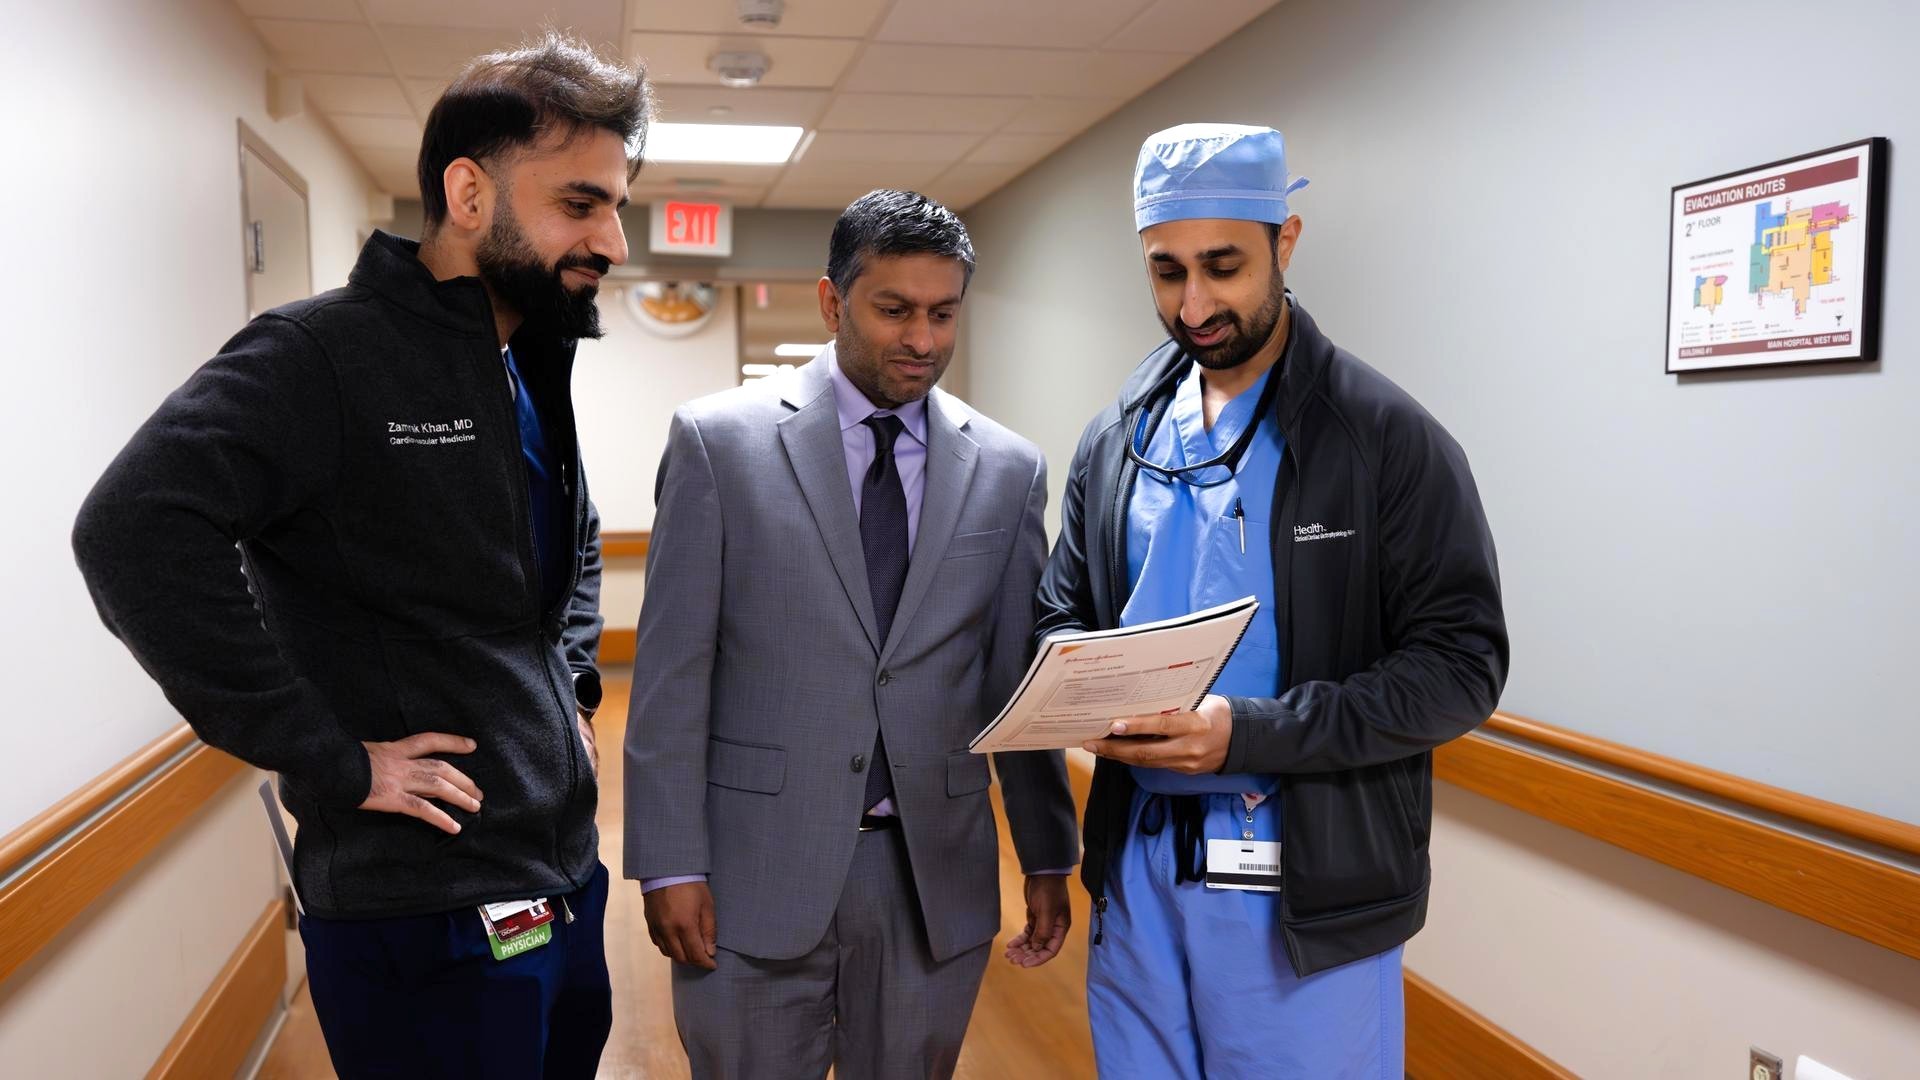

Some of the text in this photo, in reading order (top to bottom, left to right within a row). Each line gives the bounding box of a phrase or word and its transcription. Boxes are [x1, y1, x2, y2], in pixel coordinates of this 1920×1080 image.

[1685, 178, 1786, 212] EVACUATION ROUTES
[667, 203, 720, 244] EXIT
[1698, 216, 1721, 229] FLOOR
[1767, 333, 1850, 349] MAIN HOSPITAL WEST WING
[421, 422, 453, 433] Khan,
[454, 419, 473, 431] MD
[439, 434, 476, 444] Medicine
[501, 932, 546, 956] PHYSICIAN
